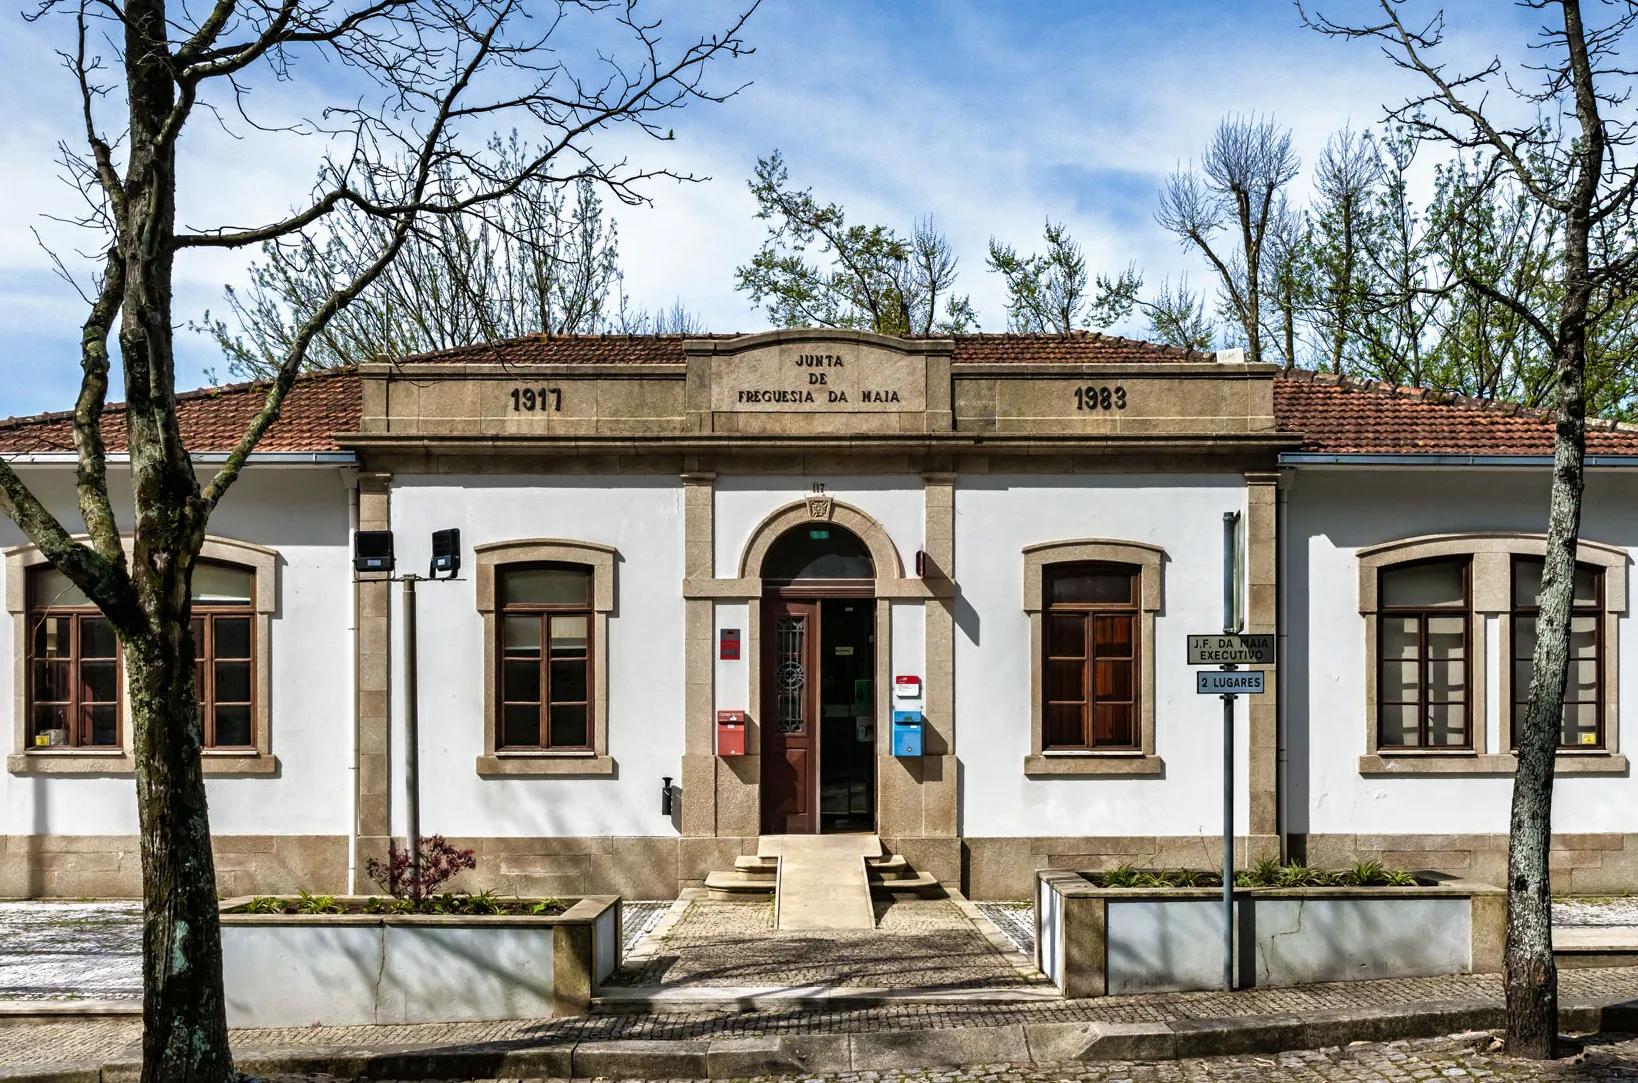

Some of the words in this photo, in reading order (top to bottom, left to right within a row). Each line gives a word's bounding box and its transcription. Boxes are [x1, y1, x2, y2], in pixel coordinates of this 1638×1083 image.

[795, 354, 844, 367] JUNTA
[808, 373, 828, 385] DE
[511, 388, 561, 411] 1917
[738, 390, 815, 403] FREGUESIA
[828, 390, 848, 403] DA
[1074, 386, 1126, 410] 1983
[1194, 639, 1211, 648] J.F.
[1218, 639, 1233, 648] DA
[1240, 639, 1268, 648] MAIA
[1200, 651, 1263, 660] EXECUTIVO
[1201, 678, 1208, 687] 2
[1213, 678, 1260, 687] LUGARES
